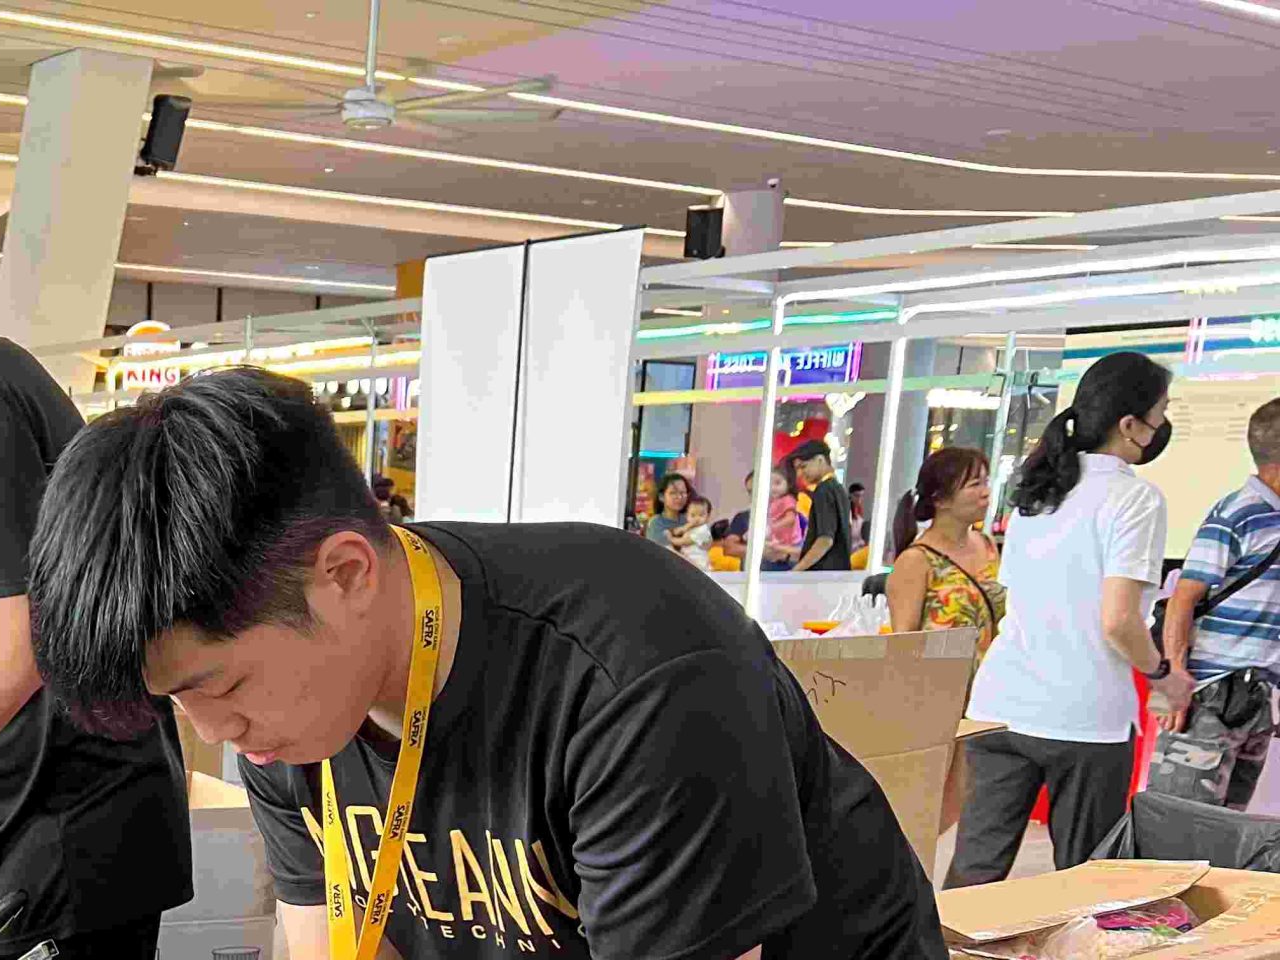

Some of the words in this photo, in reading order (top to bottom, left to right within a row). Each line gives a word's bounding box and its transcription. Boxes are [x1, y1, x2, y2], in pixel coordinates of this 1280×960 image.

[127, 367, 177, 384] KING
[423, 609, 434, 648] SAFRA
[409, 710, 422, 747] SAFRA
[388, 804, 406, 839] SAFRA
[333, 884, 343, 918] SAFRA
[371, 893, 386, 925] SAFRA
